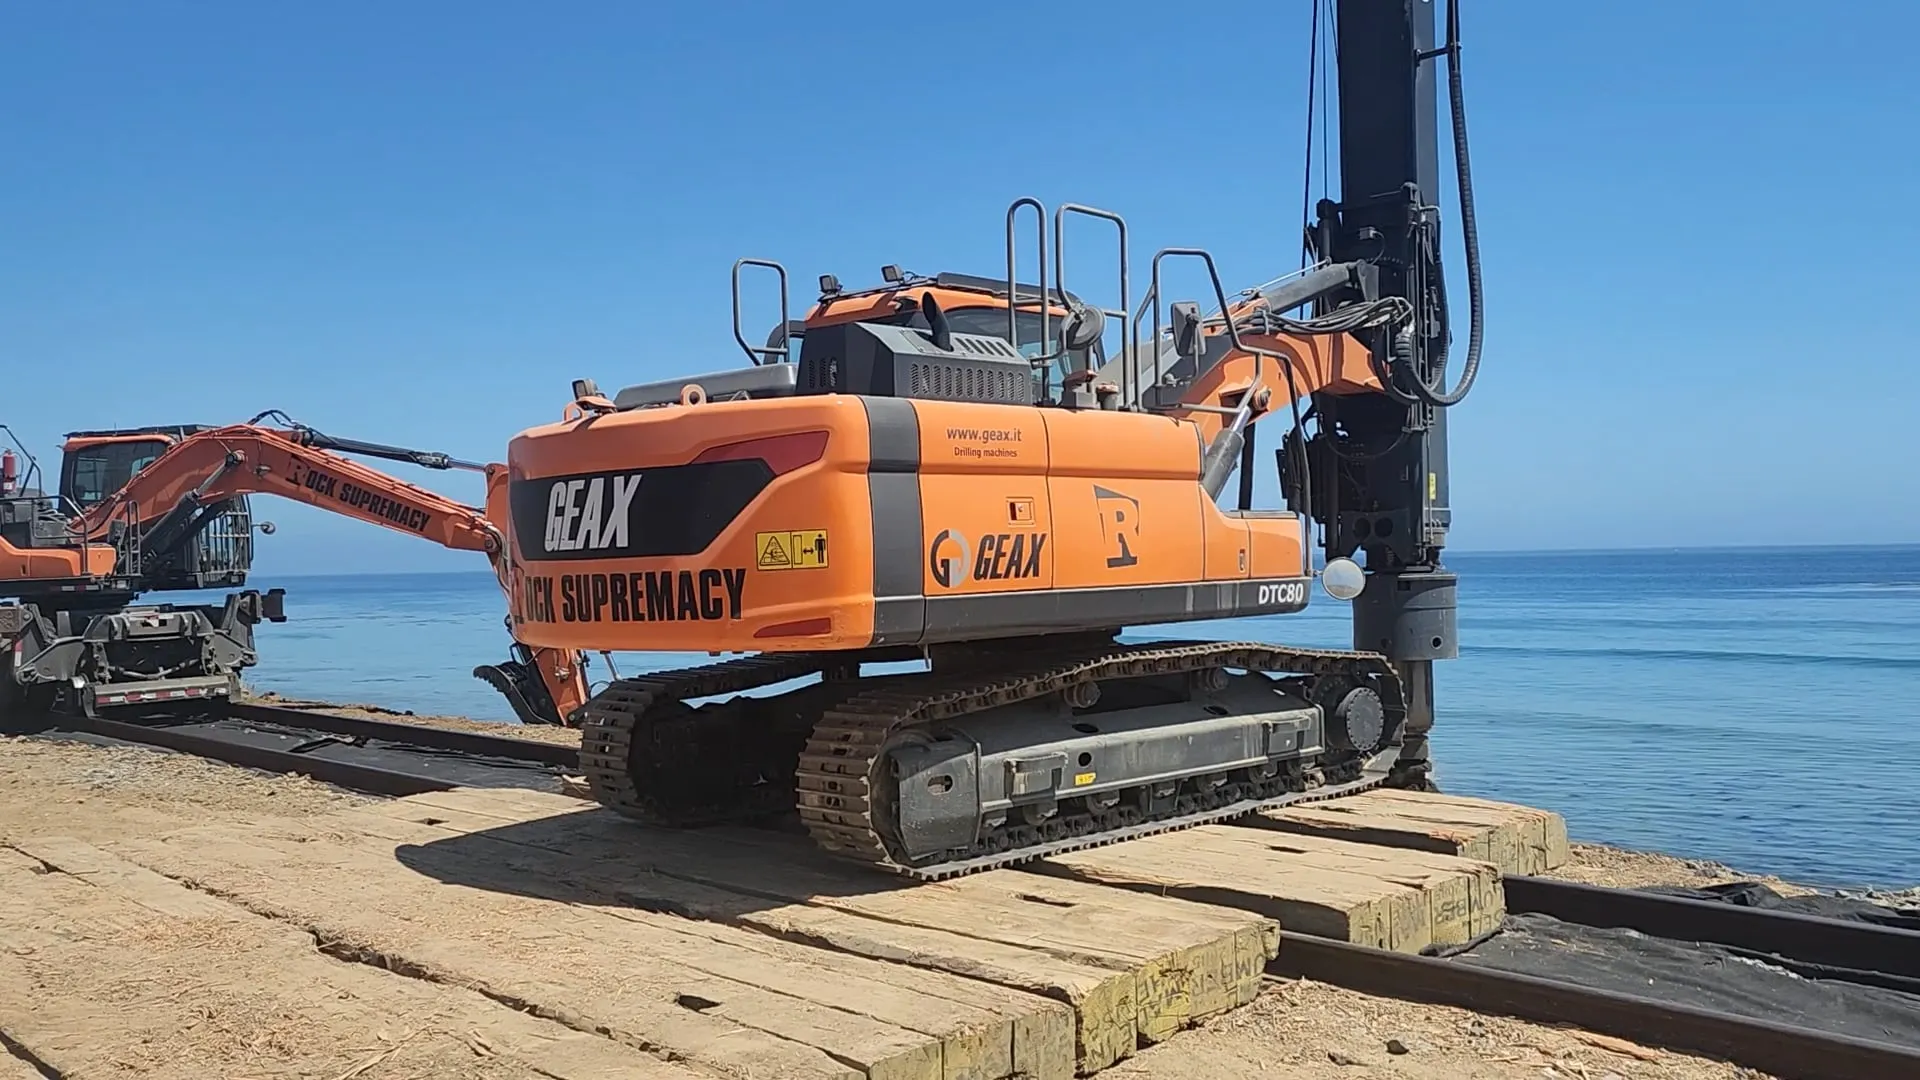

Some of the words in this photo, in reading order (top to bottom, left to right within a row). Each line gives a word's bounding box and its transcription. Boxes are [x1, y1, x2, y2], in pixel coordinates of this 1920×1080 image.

[946, 428, 1022, 444] www.geax.it
[954, 447, 981, 458] Drilling
[983, 447, 1018, 458] machines
[339, 483, 431, 532] SUPREMACY
[544, 474, 642, 553] GEAX
[973, 533, 1048, 581] GEAX
[561, 568, 747, 624] SUPREMACY
[1258, 583, 1304, 605] DTC80
